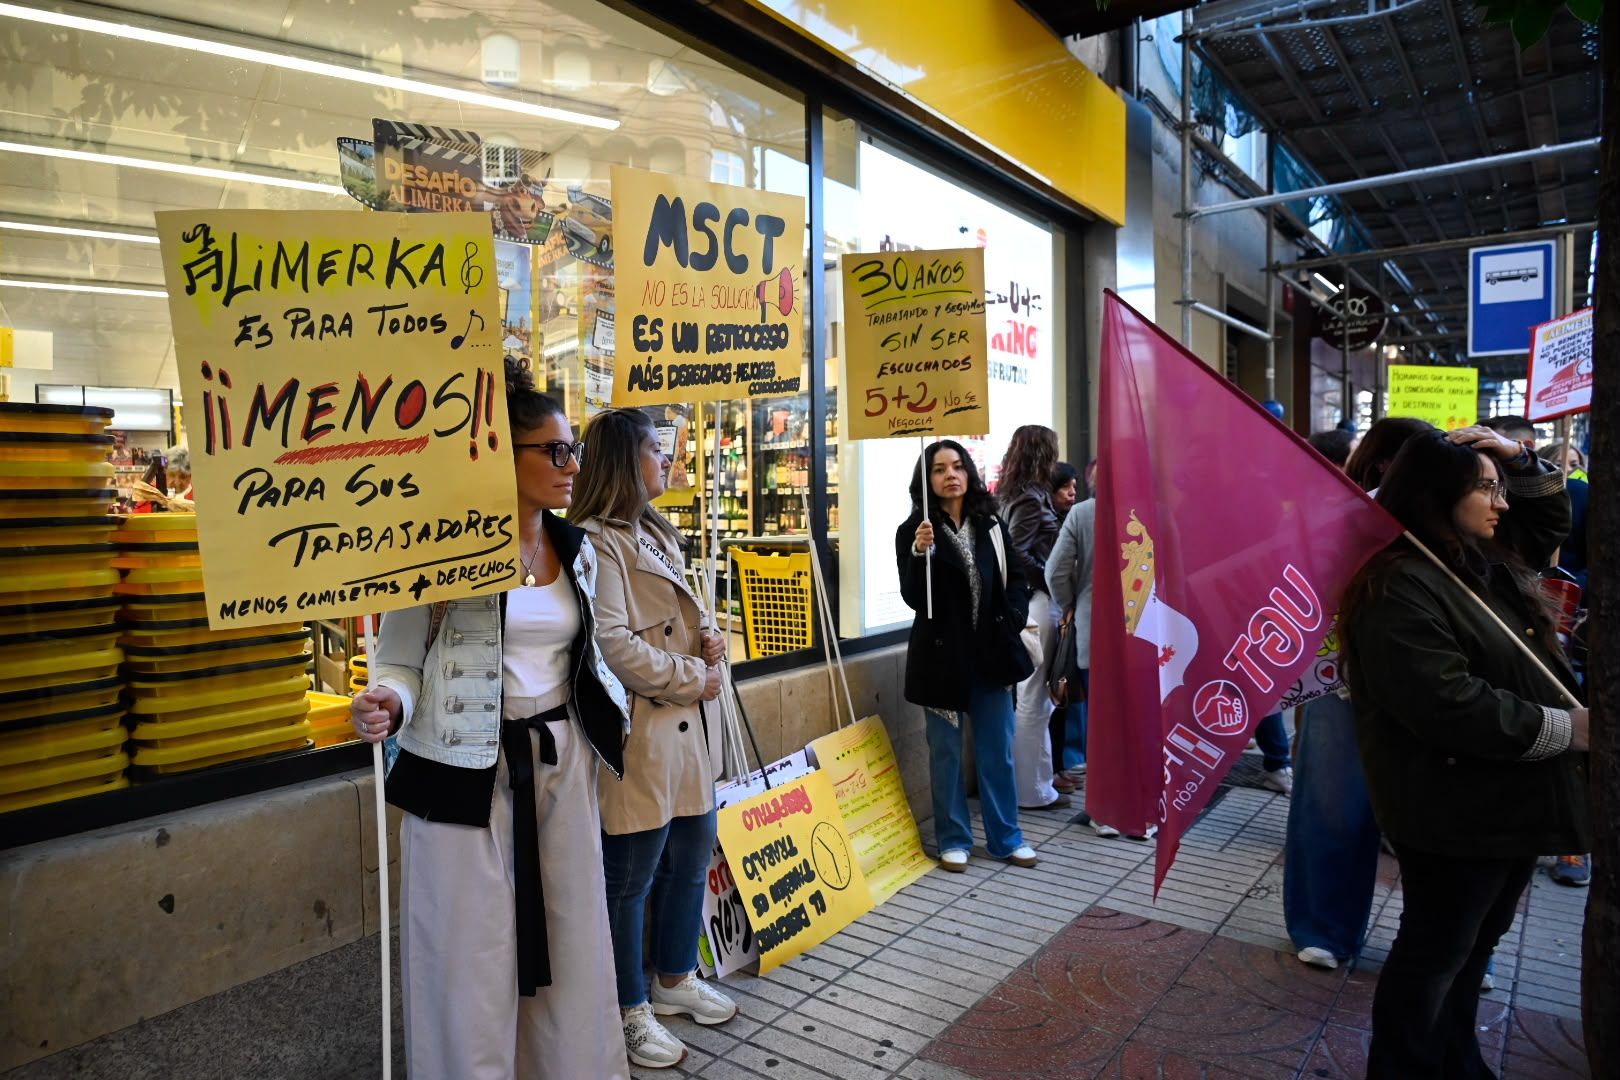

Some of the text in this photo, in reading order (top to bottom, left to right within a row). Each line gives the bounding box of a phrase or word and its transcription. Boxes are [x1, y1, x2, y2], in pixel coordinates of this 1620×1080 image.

[384, 157, 478, 198] DESAFÍO
[643, 193, 786, 275] MSCT
[642, 279, 666, 307] NO
[671, 282, 688, 307] ES
[692, 286, 706, 308] LA
[851, 257, 965, 298] 30 AÑOS
[235, 303, 448, 349] ES PARA TODOS
[632, 315, 664, 352] ES
[671, 321, 699, 353] UN
[705, 323, 789, 355] RETROCESO
[865, 309, 929, 327] TRABAJANDO
[934, 305, 942, 316] Y
[880, 323, 970, 352] SIN SER
[627, 356, 664, 392] MÁS
[877, 355, 972, 379] ESCUCHADOS
[864, 381, 977, 417] 5+2 NO SE
[889, 416, 933, 430] NEGOCIA
[233, 464, 421, 515] PARA SUS
[268, 509, 513, 567] TRABAJADORES
[220, 557, 517, 620] MENOS CAMISETAS + DERECHOS
[742, 834, 798, 882] TRABAJO
[752, 892, 770, 918] ES
[809, 889, 827, 917] EL
